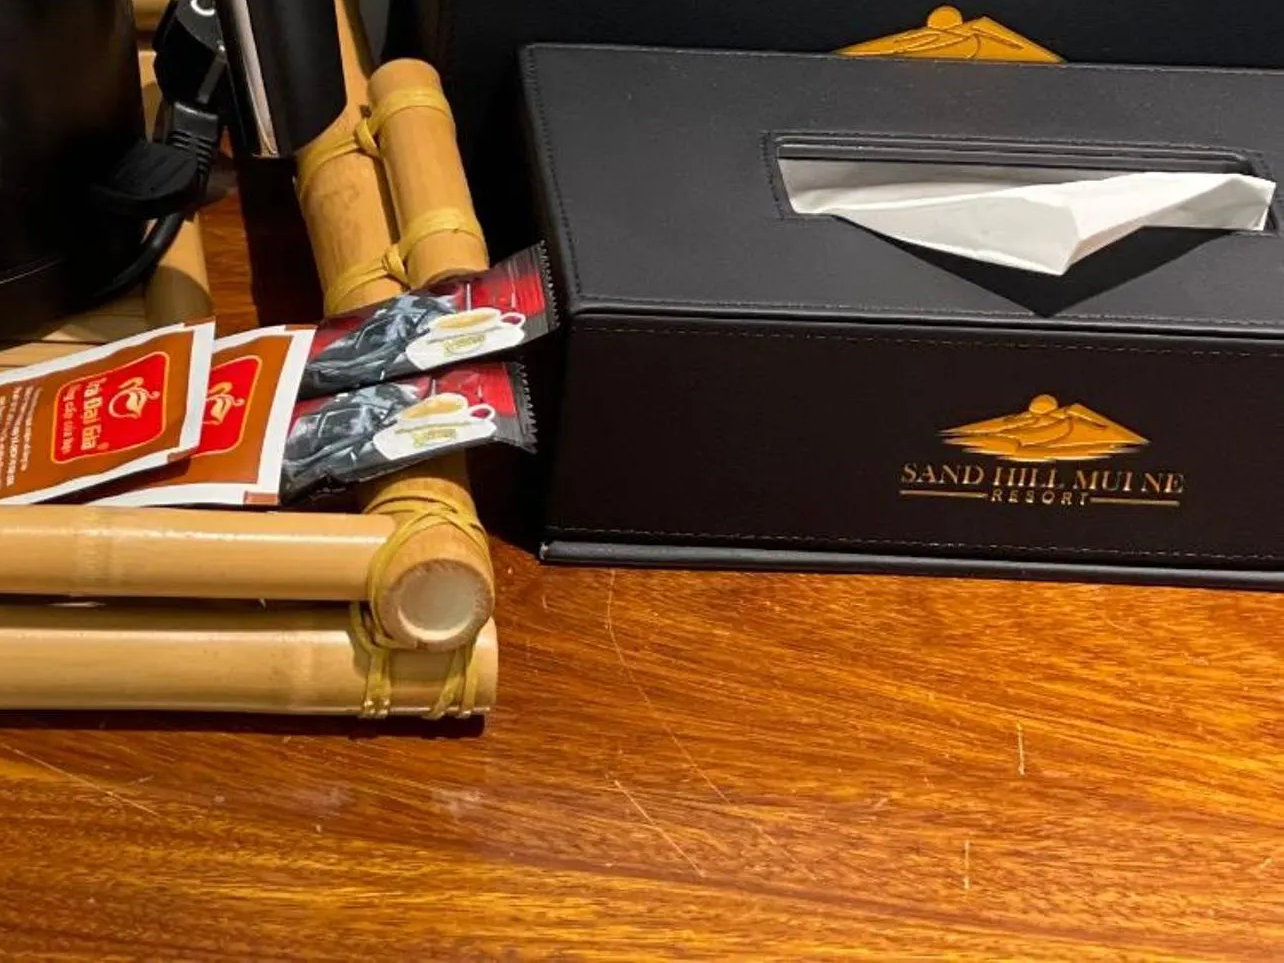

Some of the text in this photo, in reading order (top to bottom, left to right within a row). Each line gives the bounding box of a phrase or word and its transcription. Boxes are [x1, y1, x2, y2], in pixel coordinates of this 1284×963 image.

[900, 463, 1184, 494] SAND HILL MUI NE
[990, 488, 1090, 506] RESORT
